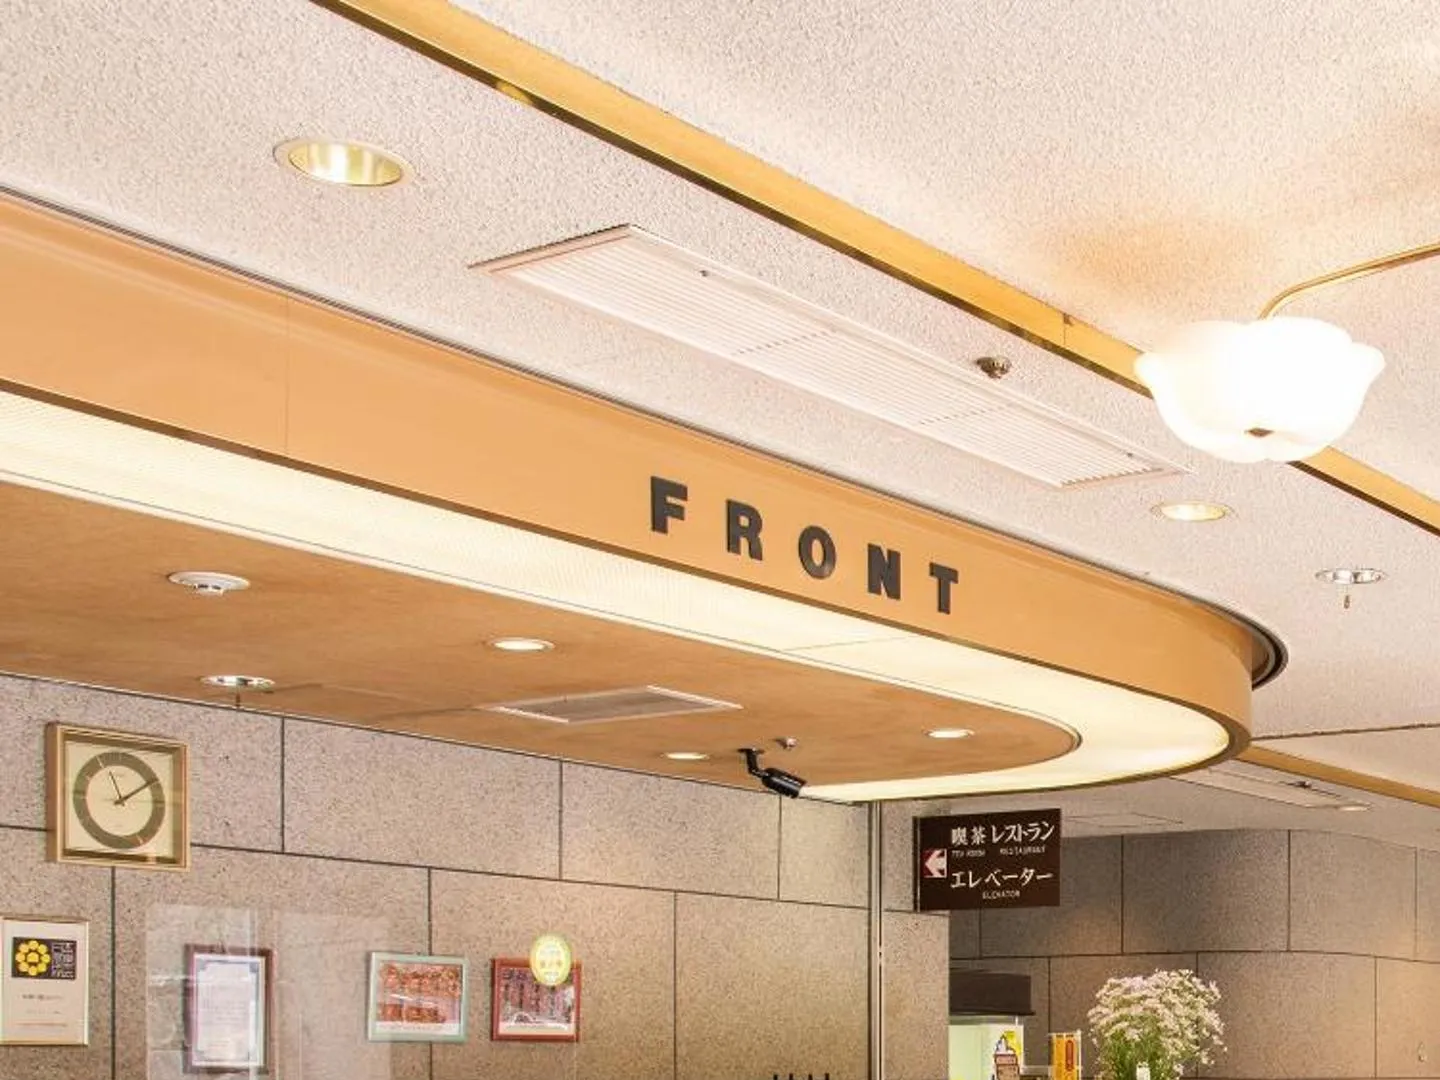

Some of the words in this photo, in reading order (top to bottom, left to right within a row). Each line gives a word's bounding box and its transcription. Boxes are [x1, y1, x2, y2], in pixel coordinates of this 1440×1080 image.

[650, 476, 958, 615] FRONT
[950, 826, 987, 846] 喫茶
[991, 821, 1055, 844] レストラン
[950, 867, 1054, 889] エレベーター
